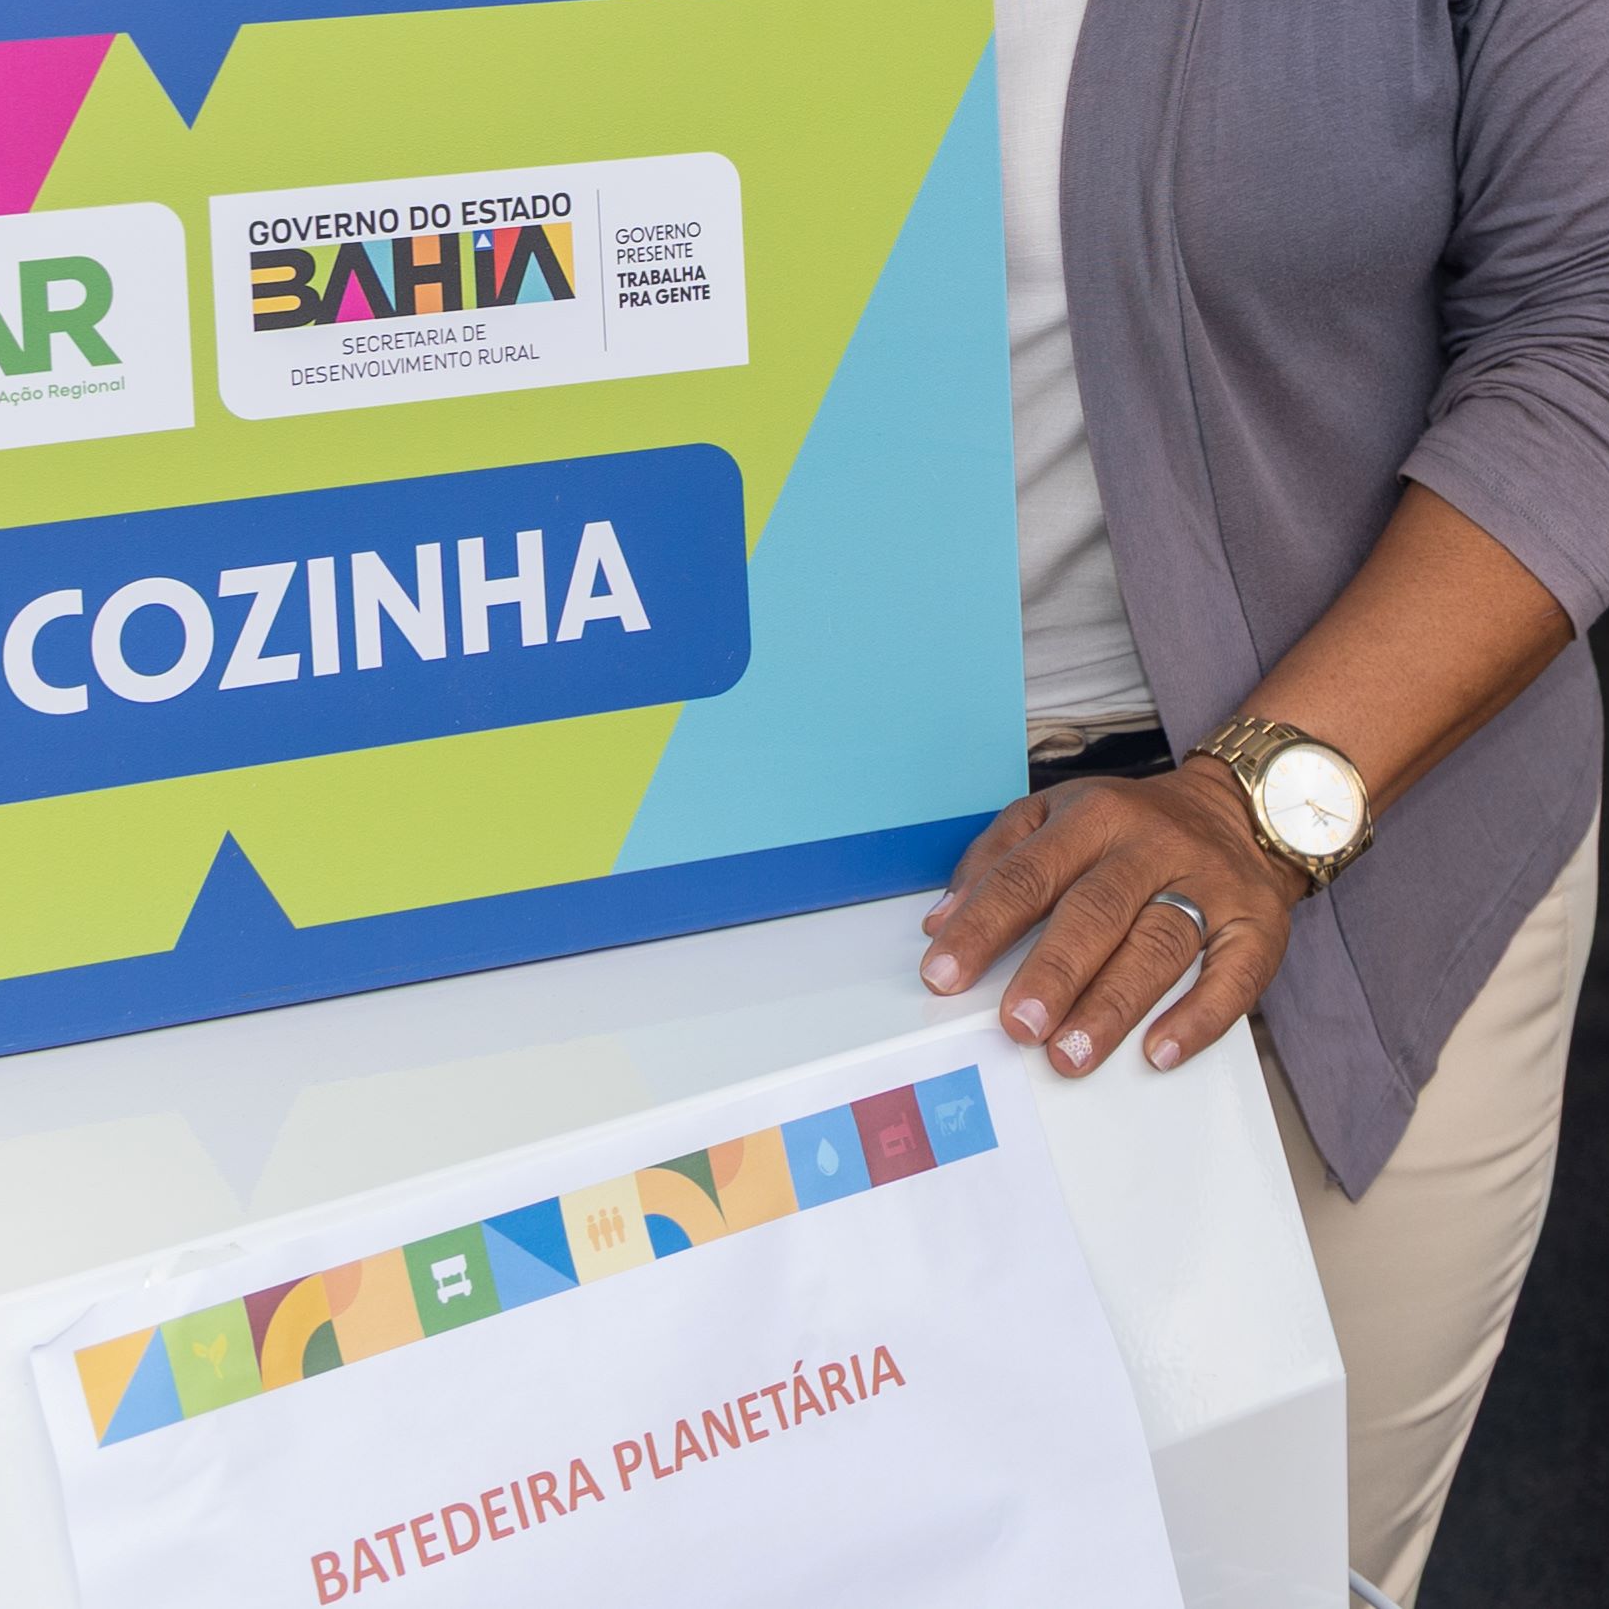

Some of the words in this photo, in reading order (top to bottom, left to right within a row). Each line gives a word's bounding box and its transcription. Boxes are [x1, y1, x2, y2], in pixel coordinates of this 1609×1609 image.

[248, 208, 399, 246] GOVERNO
[409, 203, 451, 231] DO
[461, 192, 572, 226] ESTADO
[615, 222, 702, 245] GOVERNO
[616, 243, 693, 265] PRESENTE
[250, 223, 576, 332] BAHIA
[617, 266, 707, 289] TRABALHA
[618, 290, 652, 309] PRA
[655, 285, 711, 305] GENTE
[342, 328, 457, 356] SECRETARIA
[462, 324, 487, 343] DE
[291, 349, 472, 387] DESENVOLVIMENTO
[478, 343, 540, 366] RURAL
[48, 376, 126, 402] Regional
[2, 520, 652, 716] COZINHA
[310, 1457, 606, 1606] BATEDEIRA
[612, 1345, 906, 1492] PLANETÁRIA
